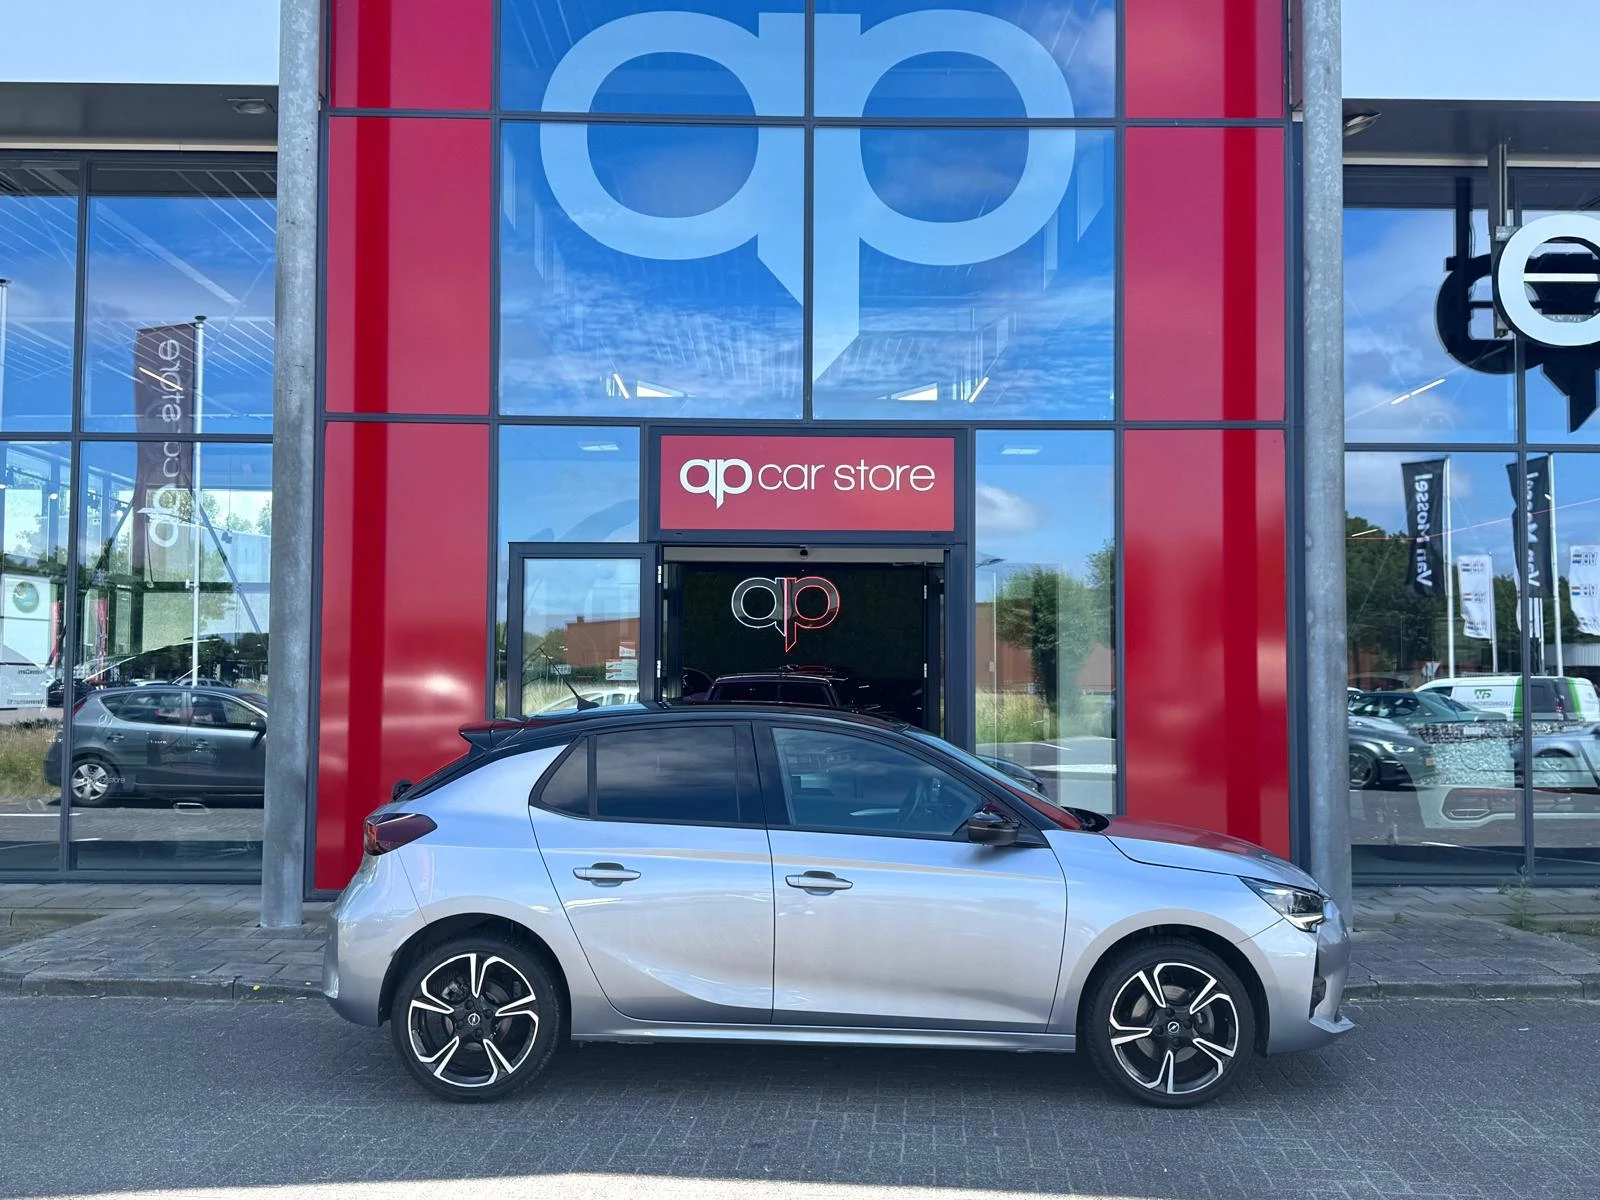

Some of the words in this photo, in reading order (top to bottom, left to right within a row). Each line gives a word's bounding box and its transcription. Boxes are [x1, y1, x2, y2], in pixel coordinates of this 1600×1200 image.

[679, 458, 753, 508] ap
[757, 462, 825, 491] car
[834, 458, 935, 491] store
